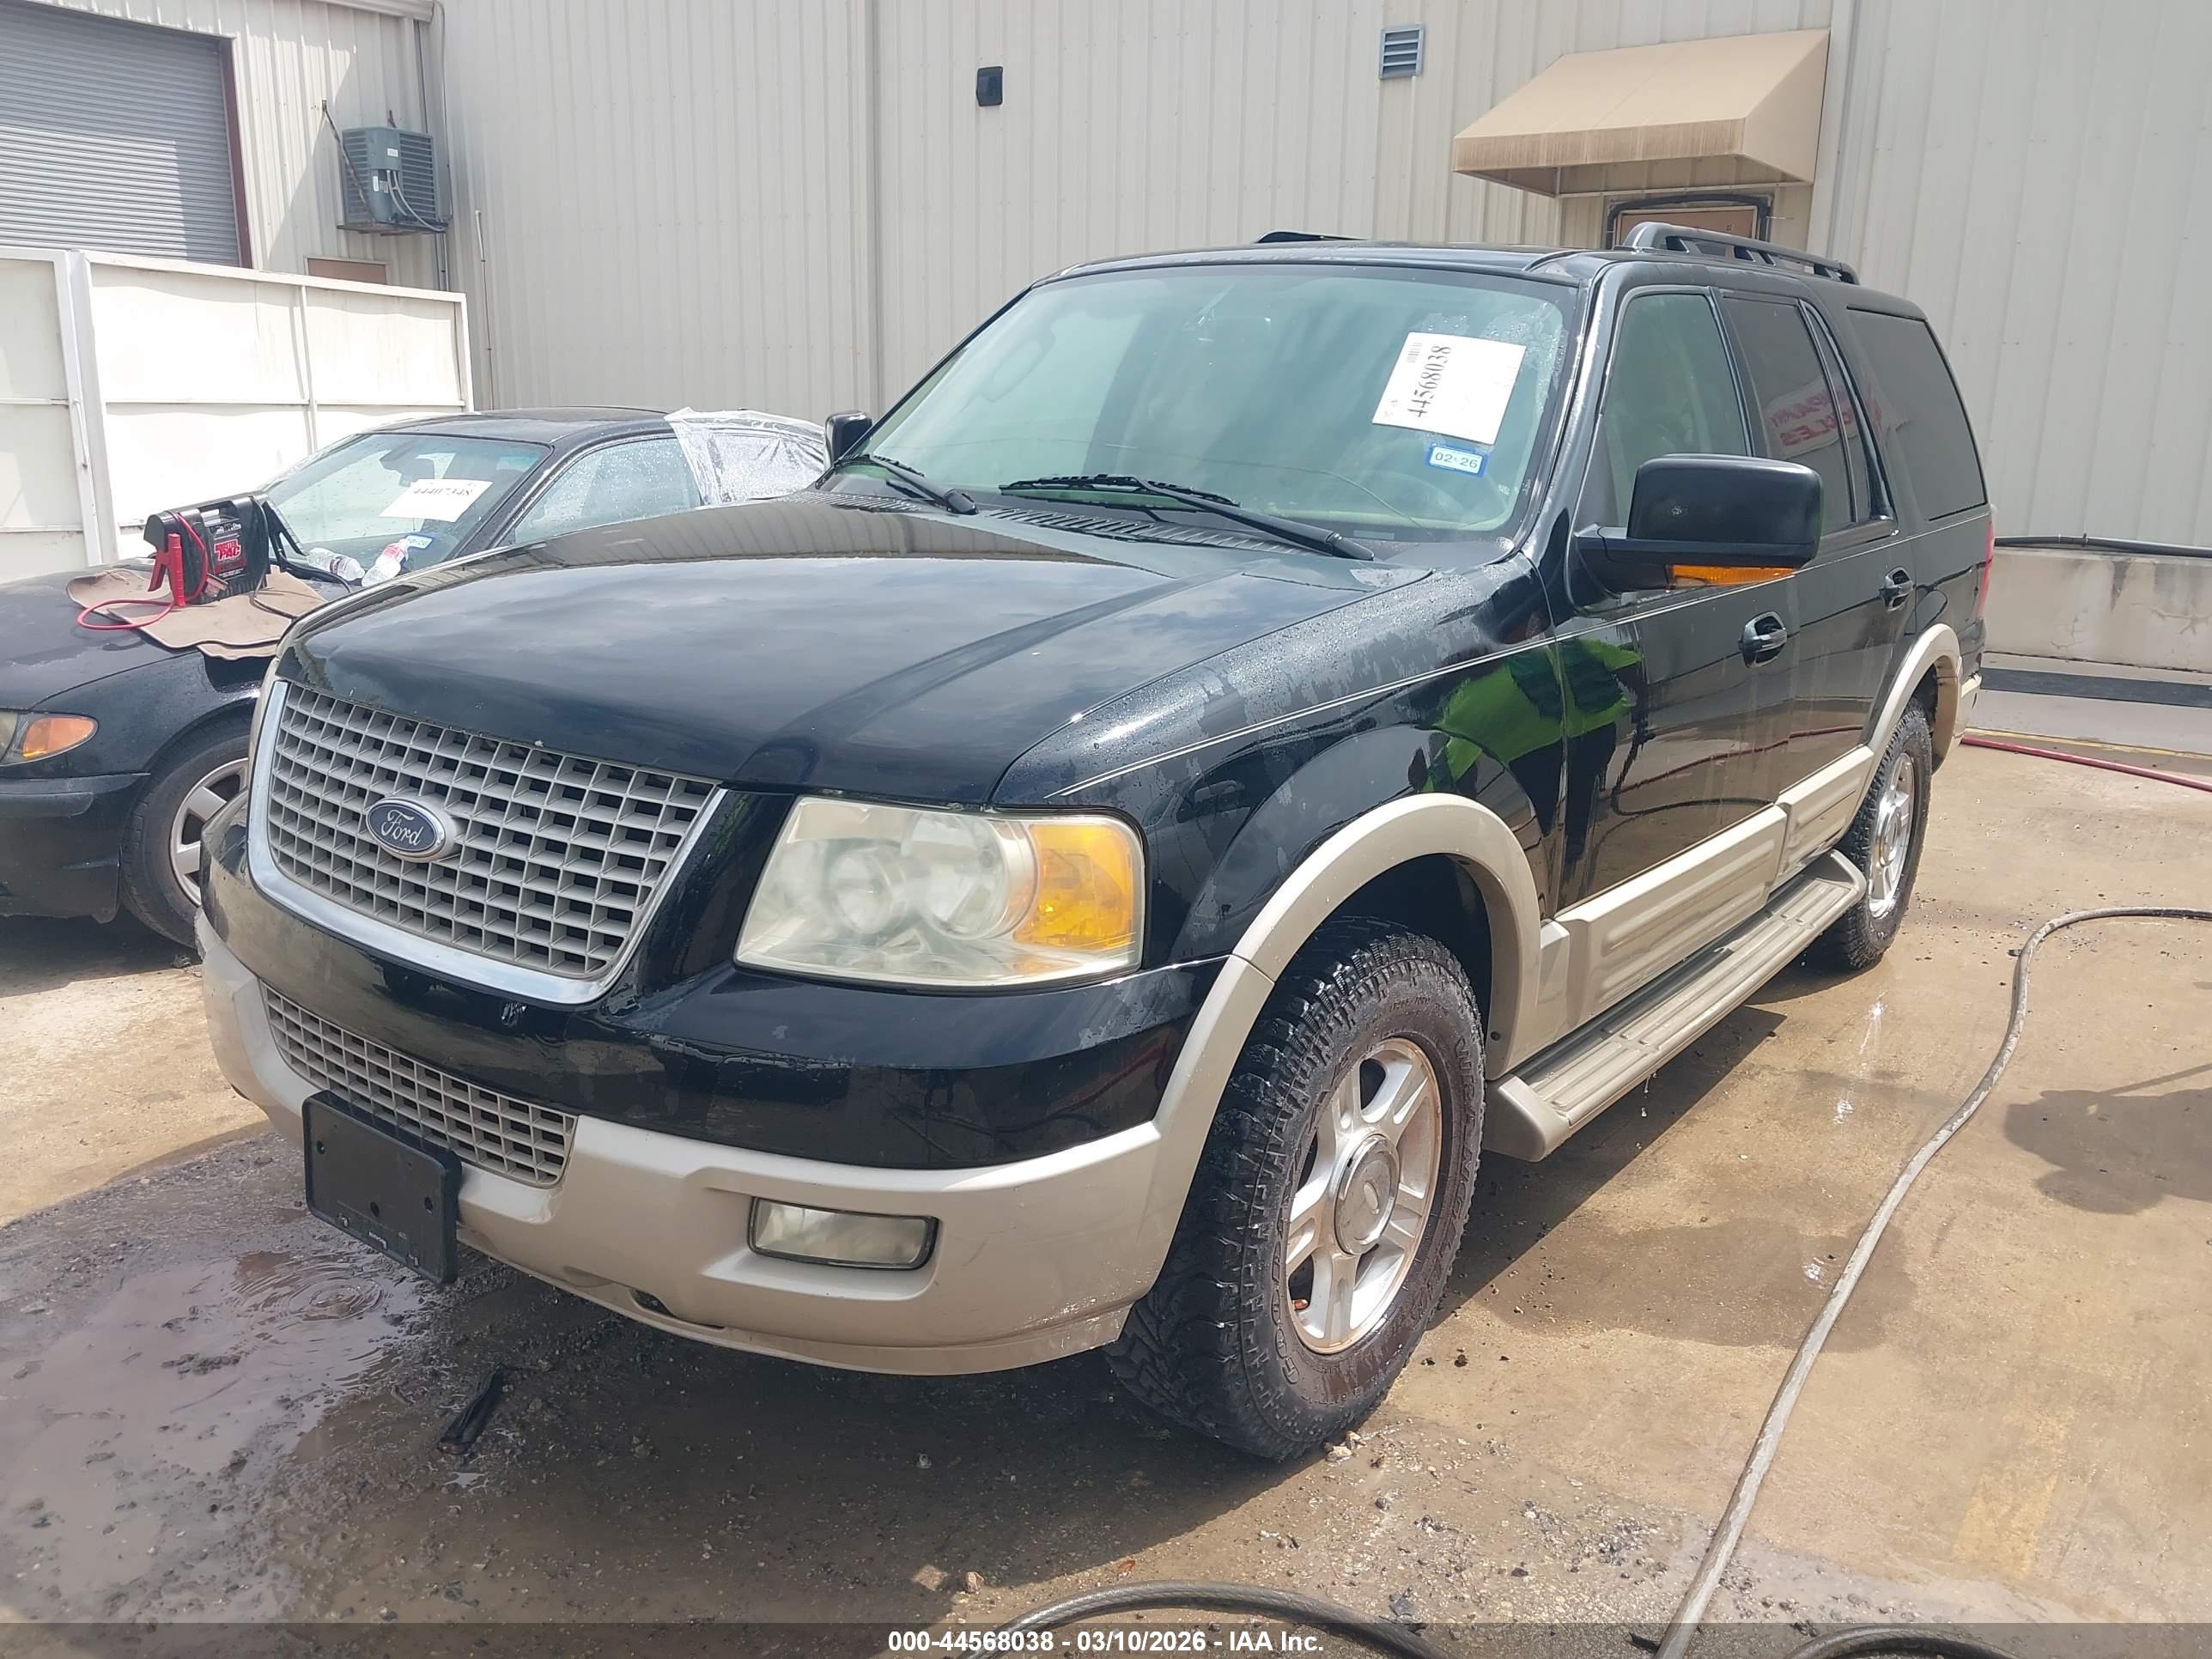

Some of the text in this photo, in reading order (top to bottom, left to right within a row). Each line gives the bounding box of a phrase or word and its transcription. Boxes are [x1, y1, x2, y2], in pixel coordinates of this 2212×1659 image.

[1407, 346, 1452, 418] 44568038
[218, 546, 241, 561] PAC
[380, 809, 424, 846] Ford
